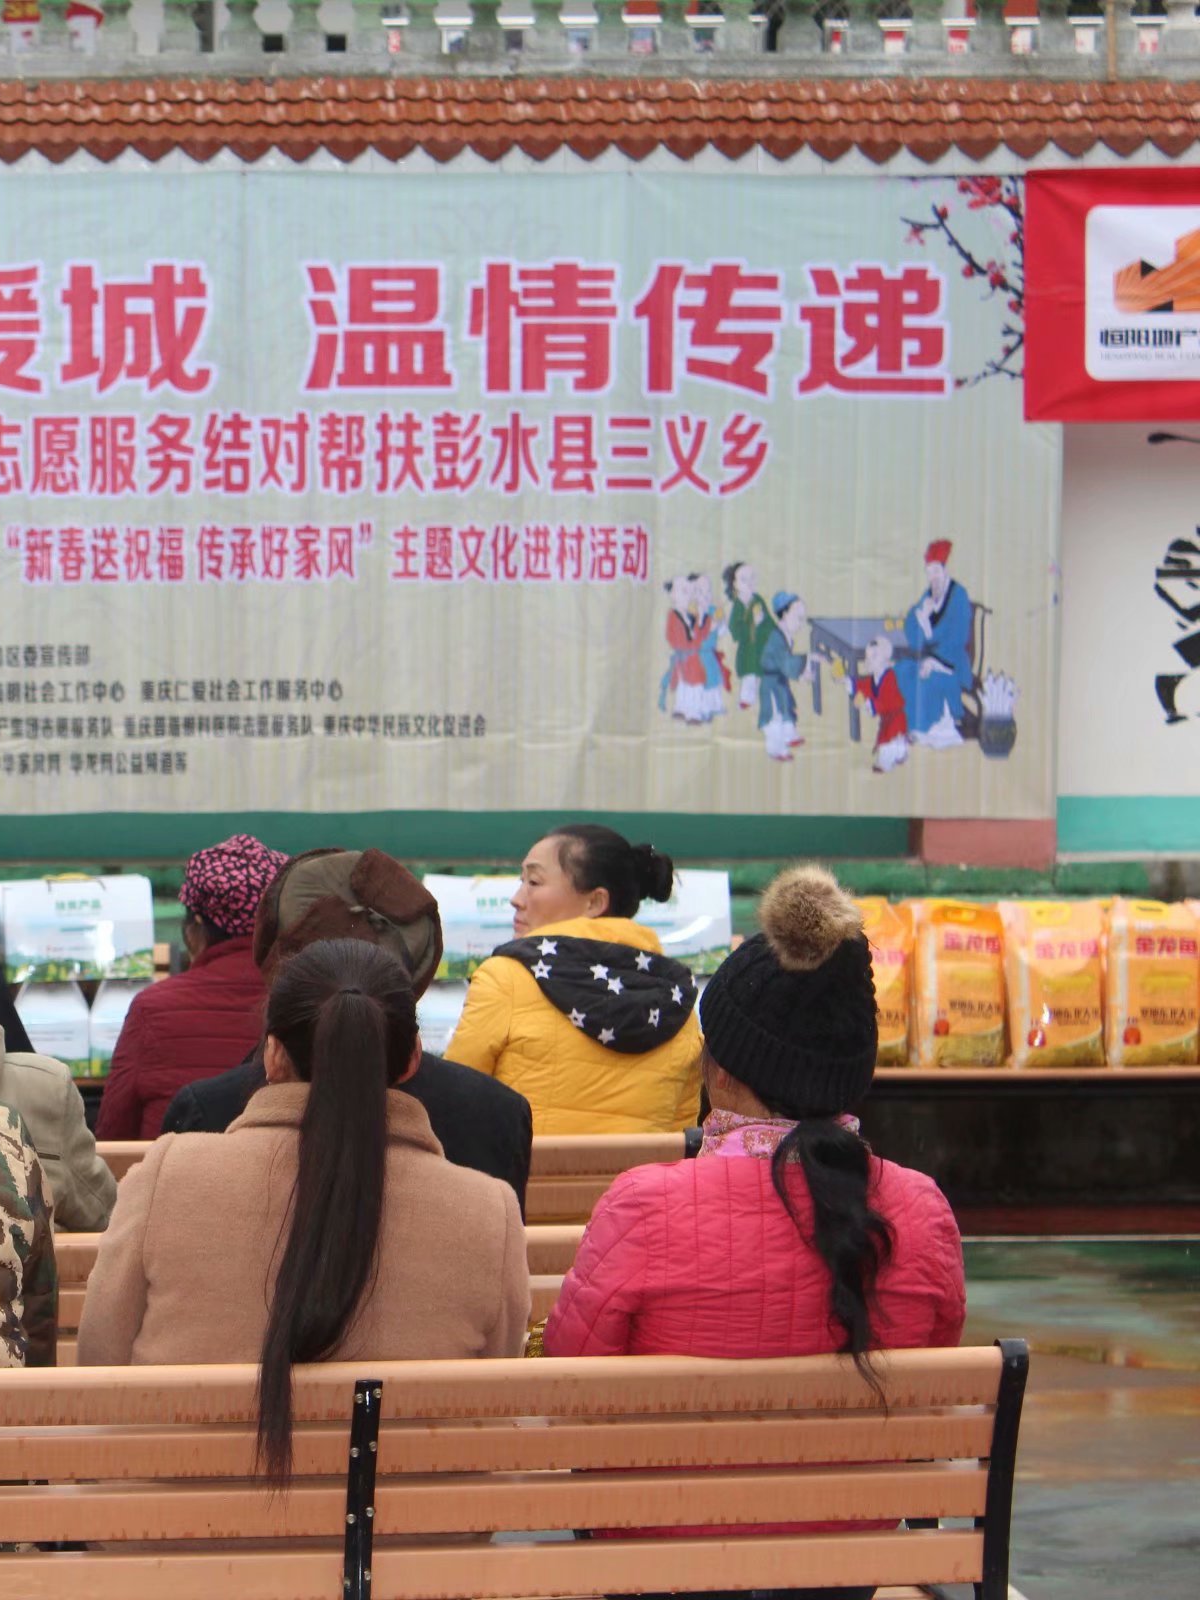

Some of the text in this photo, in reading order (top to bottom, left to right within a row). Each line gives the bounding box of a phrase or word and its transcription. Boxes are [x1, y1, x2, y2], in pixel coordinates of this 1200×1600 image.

[308, 262, 946, 398] 温情传递
[392, 525, 648, 580] 主题文化进村活动
[1136, 936, 1198, 957] 金龙鱼
